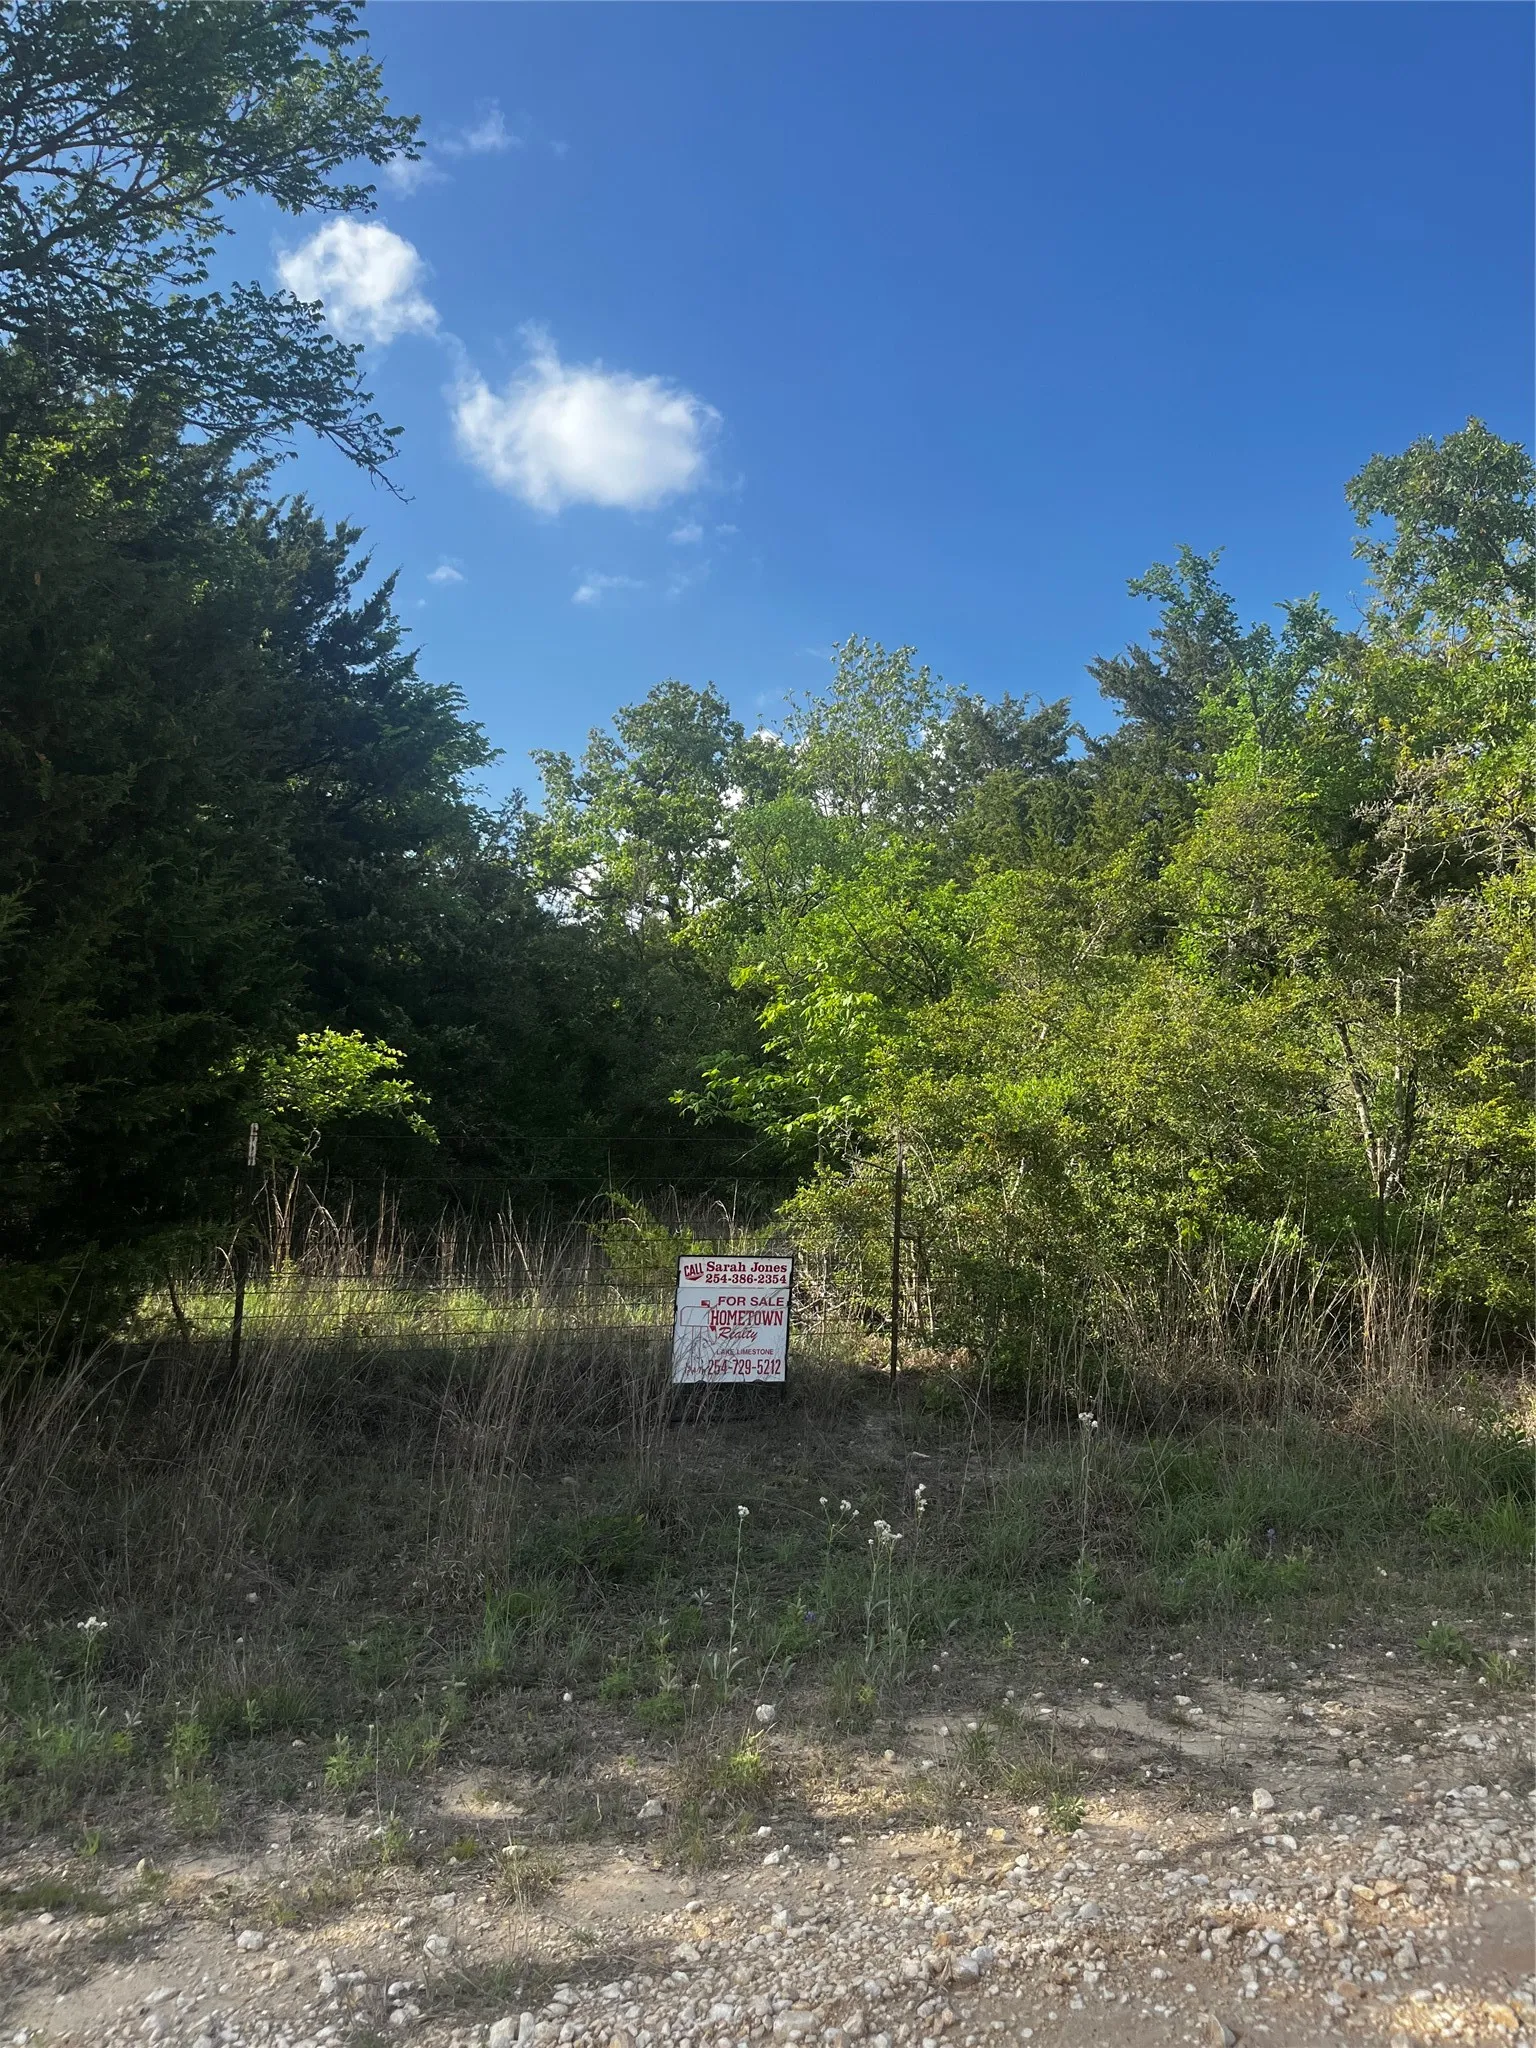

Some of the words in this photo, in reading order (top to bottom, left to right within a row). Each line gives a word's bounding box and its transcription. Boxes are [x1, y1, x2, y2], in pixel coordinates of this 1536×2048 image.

[684, 1263, 704, 1277] CALL
[706, 1261, 746, 1272] Sarah
[751, 1262, 787, 1272] Jones
[705, 1274, 787, 1284] 254-386-2354
[718, 1296, 746, 1306] FOR
[750, 1296, 785, 1306] SALE
[710, 1310, 783, 1326] HOMETOWN
[718, 1327, 758, 1342] Realty
[708, 1359, 781, 1375] 254-729-5212
